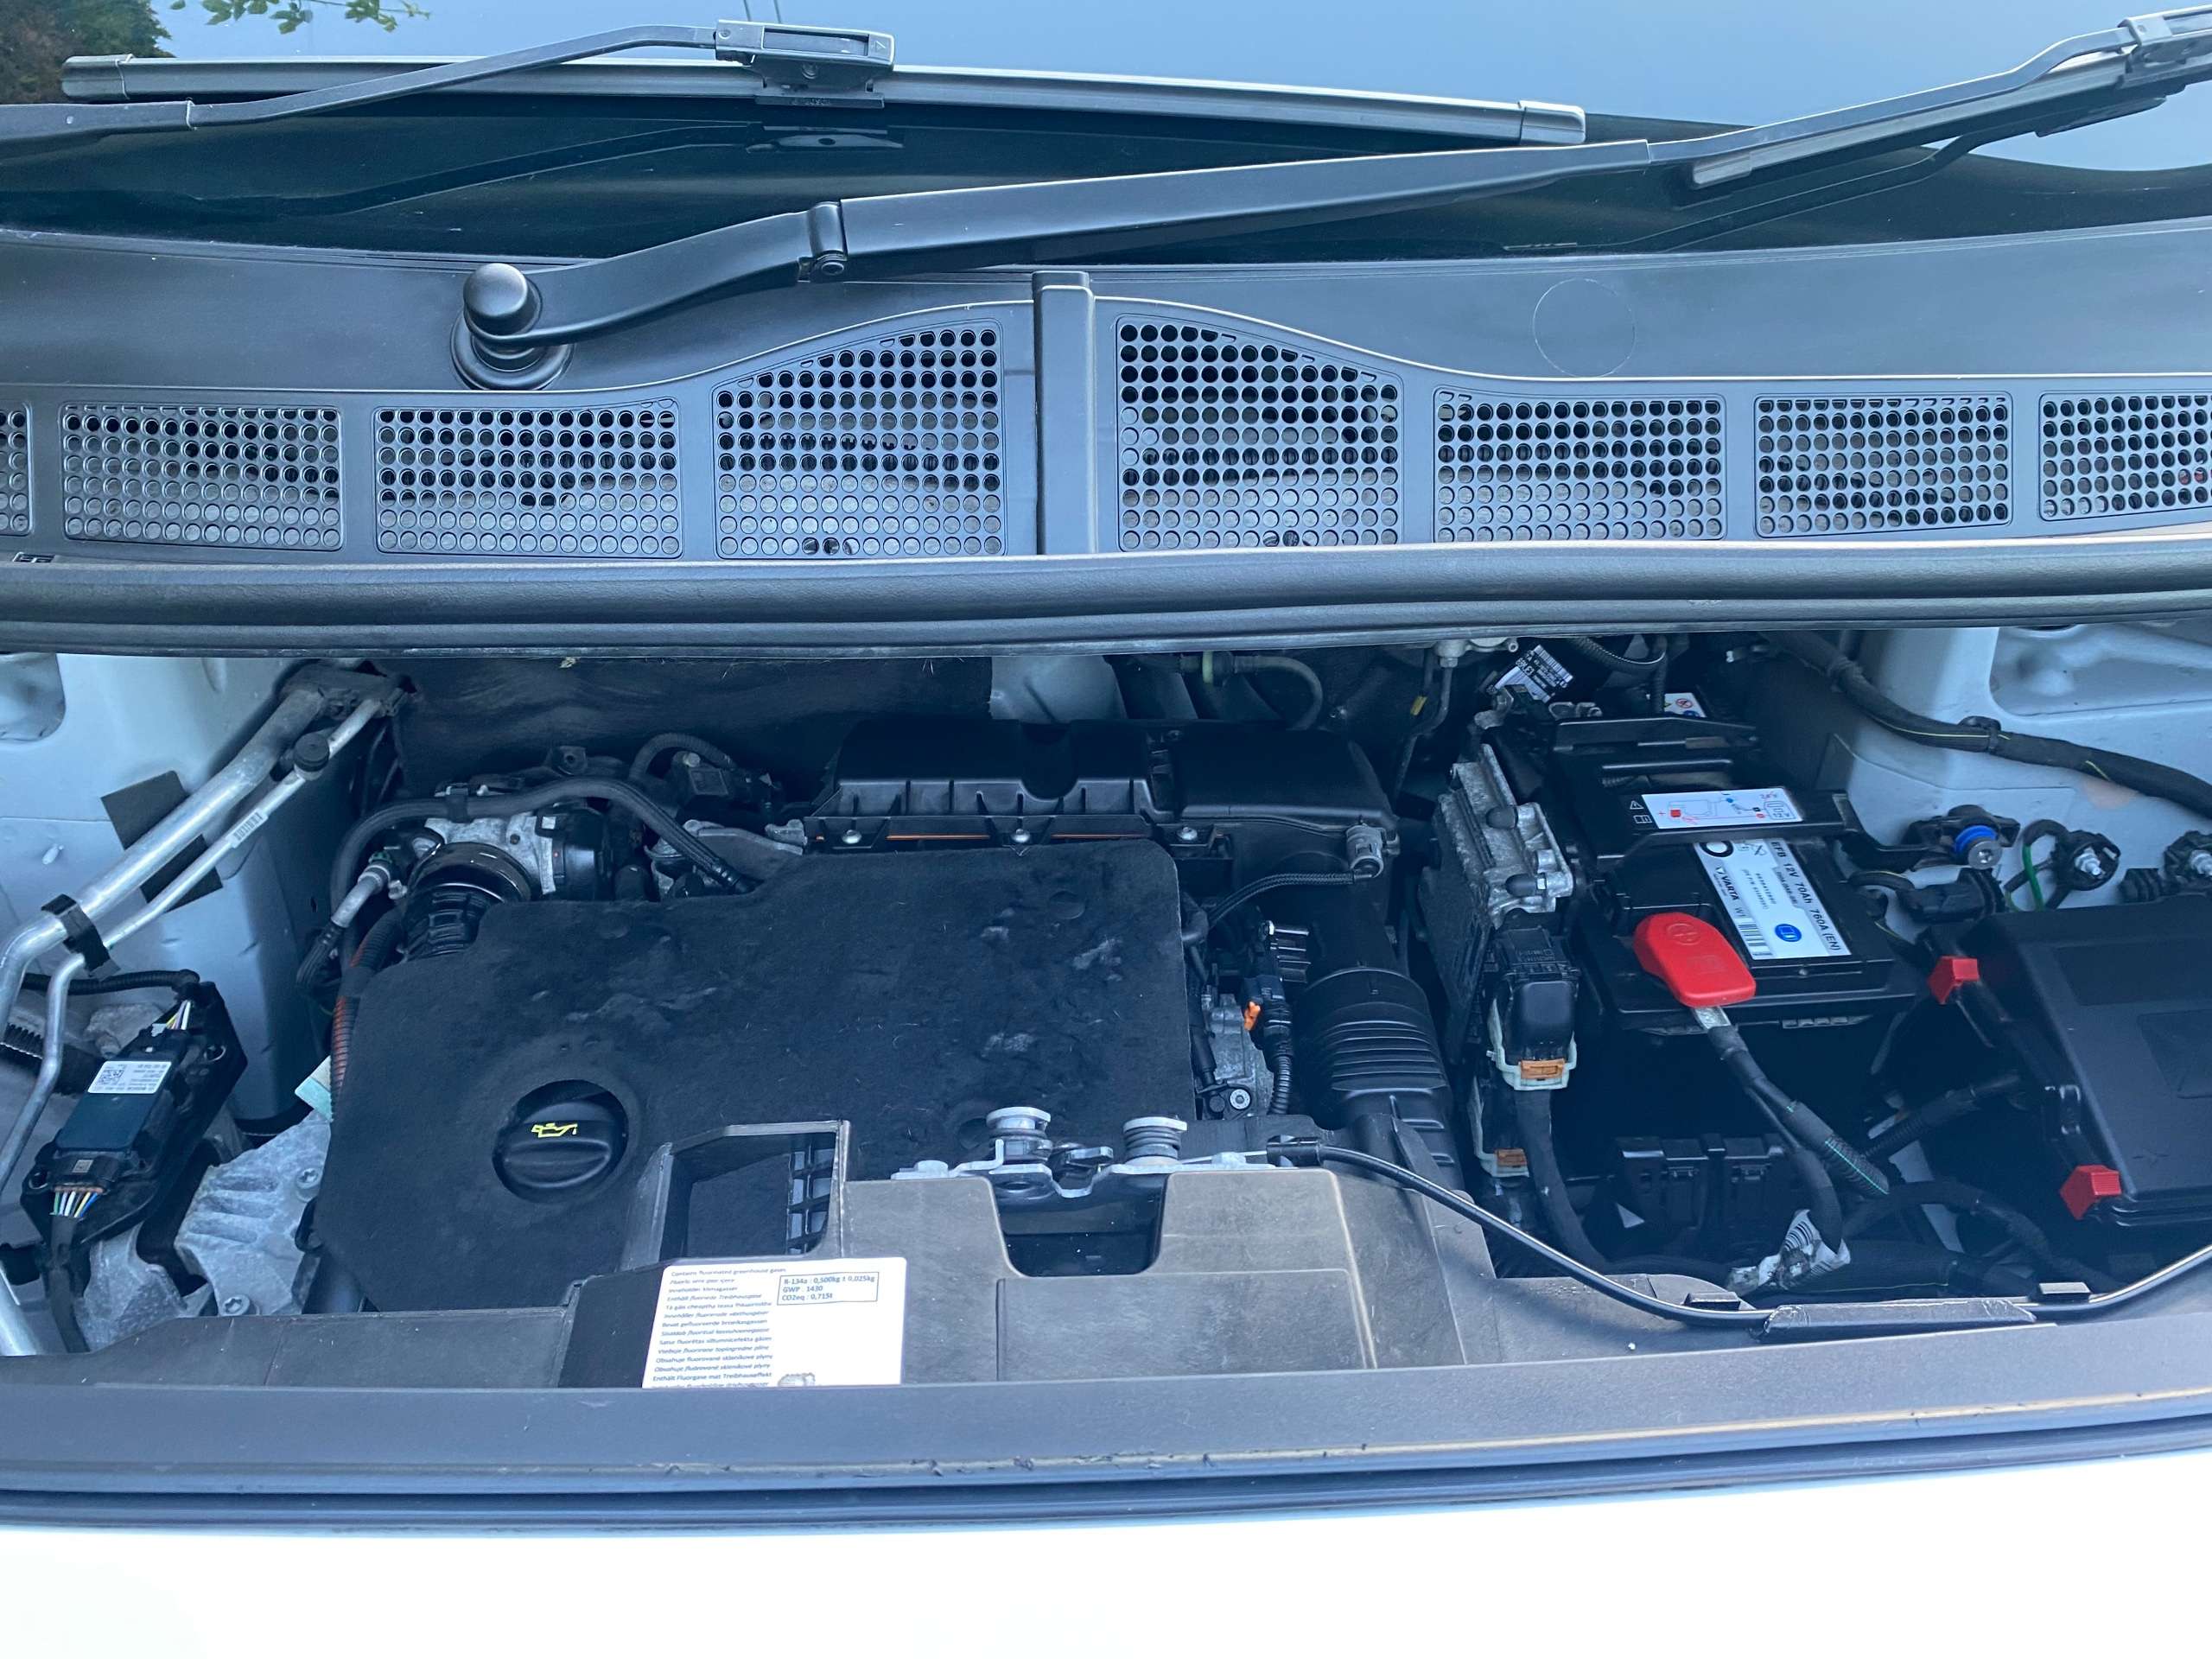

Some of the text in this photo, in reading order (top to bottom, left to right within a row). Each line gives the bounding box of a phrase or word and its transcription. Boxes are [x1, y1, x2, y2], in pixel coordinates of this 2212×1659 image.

[1721, 875, 1740, 900] VARTA
[1770, 841, 1787, 858] EFB
[1783, 862, 1800, 878] 12V
[1796, 882, 1813, 905] 70Ah
[1810, 909, 1828, 931] 760A
[1823, 933, 1841, 951] (EN)
